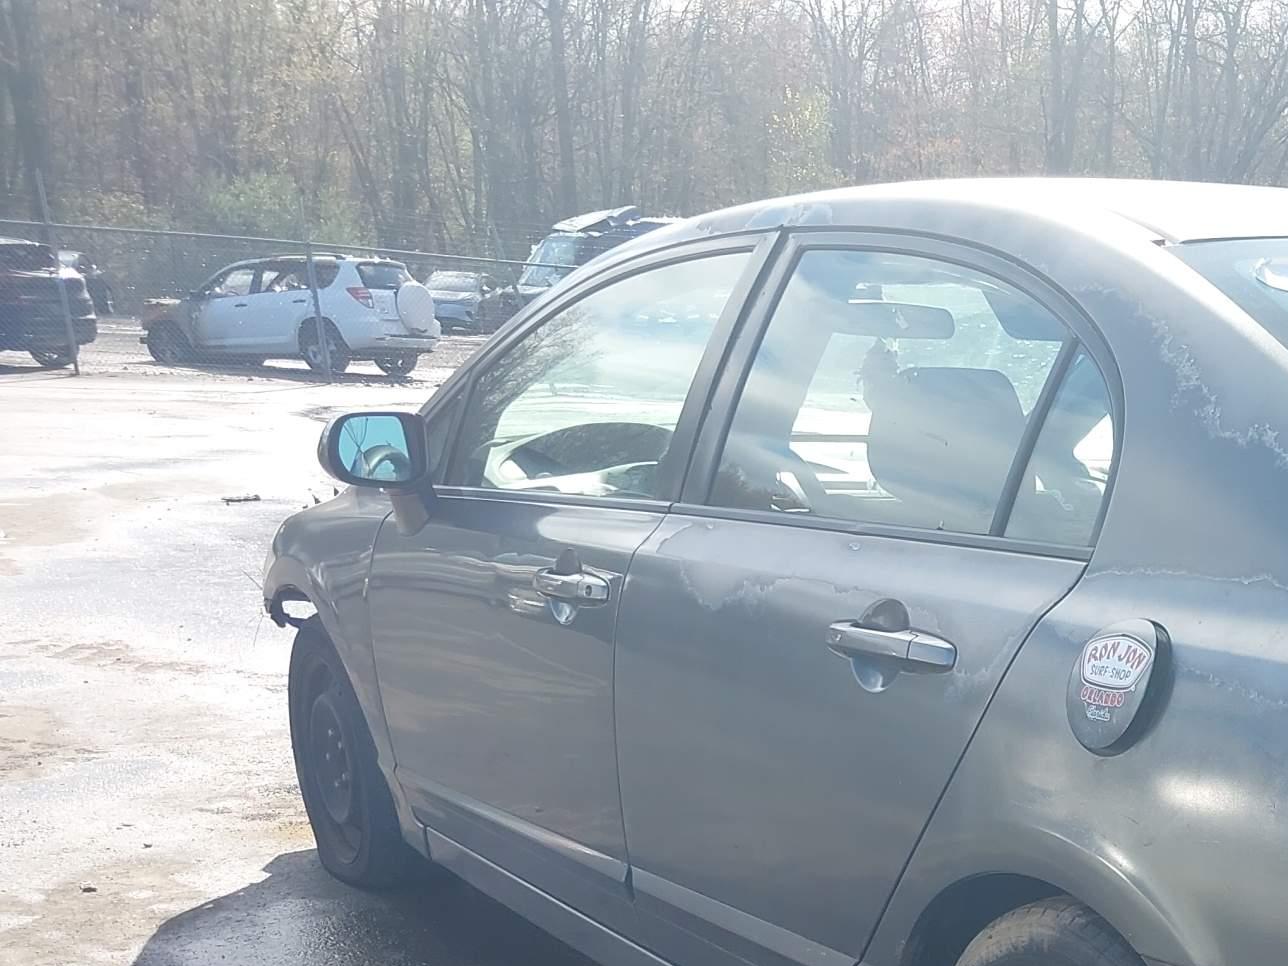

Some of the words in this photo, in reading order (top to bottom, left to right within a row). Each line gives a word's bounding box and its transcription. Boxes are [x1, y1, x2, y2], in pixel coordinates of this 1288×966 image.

[1087, 641, 1120, 664] RON
[1118, 645, 1146, 670] JON
[1090, 664, 1132, 681] SURF-SHOP
[1081, 687, 1124, 707] ORLANDO
